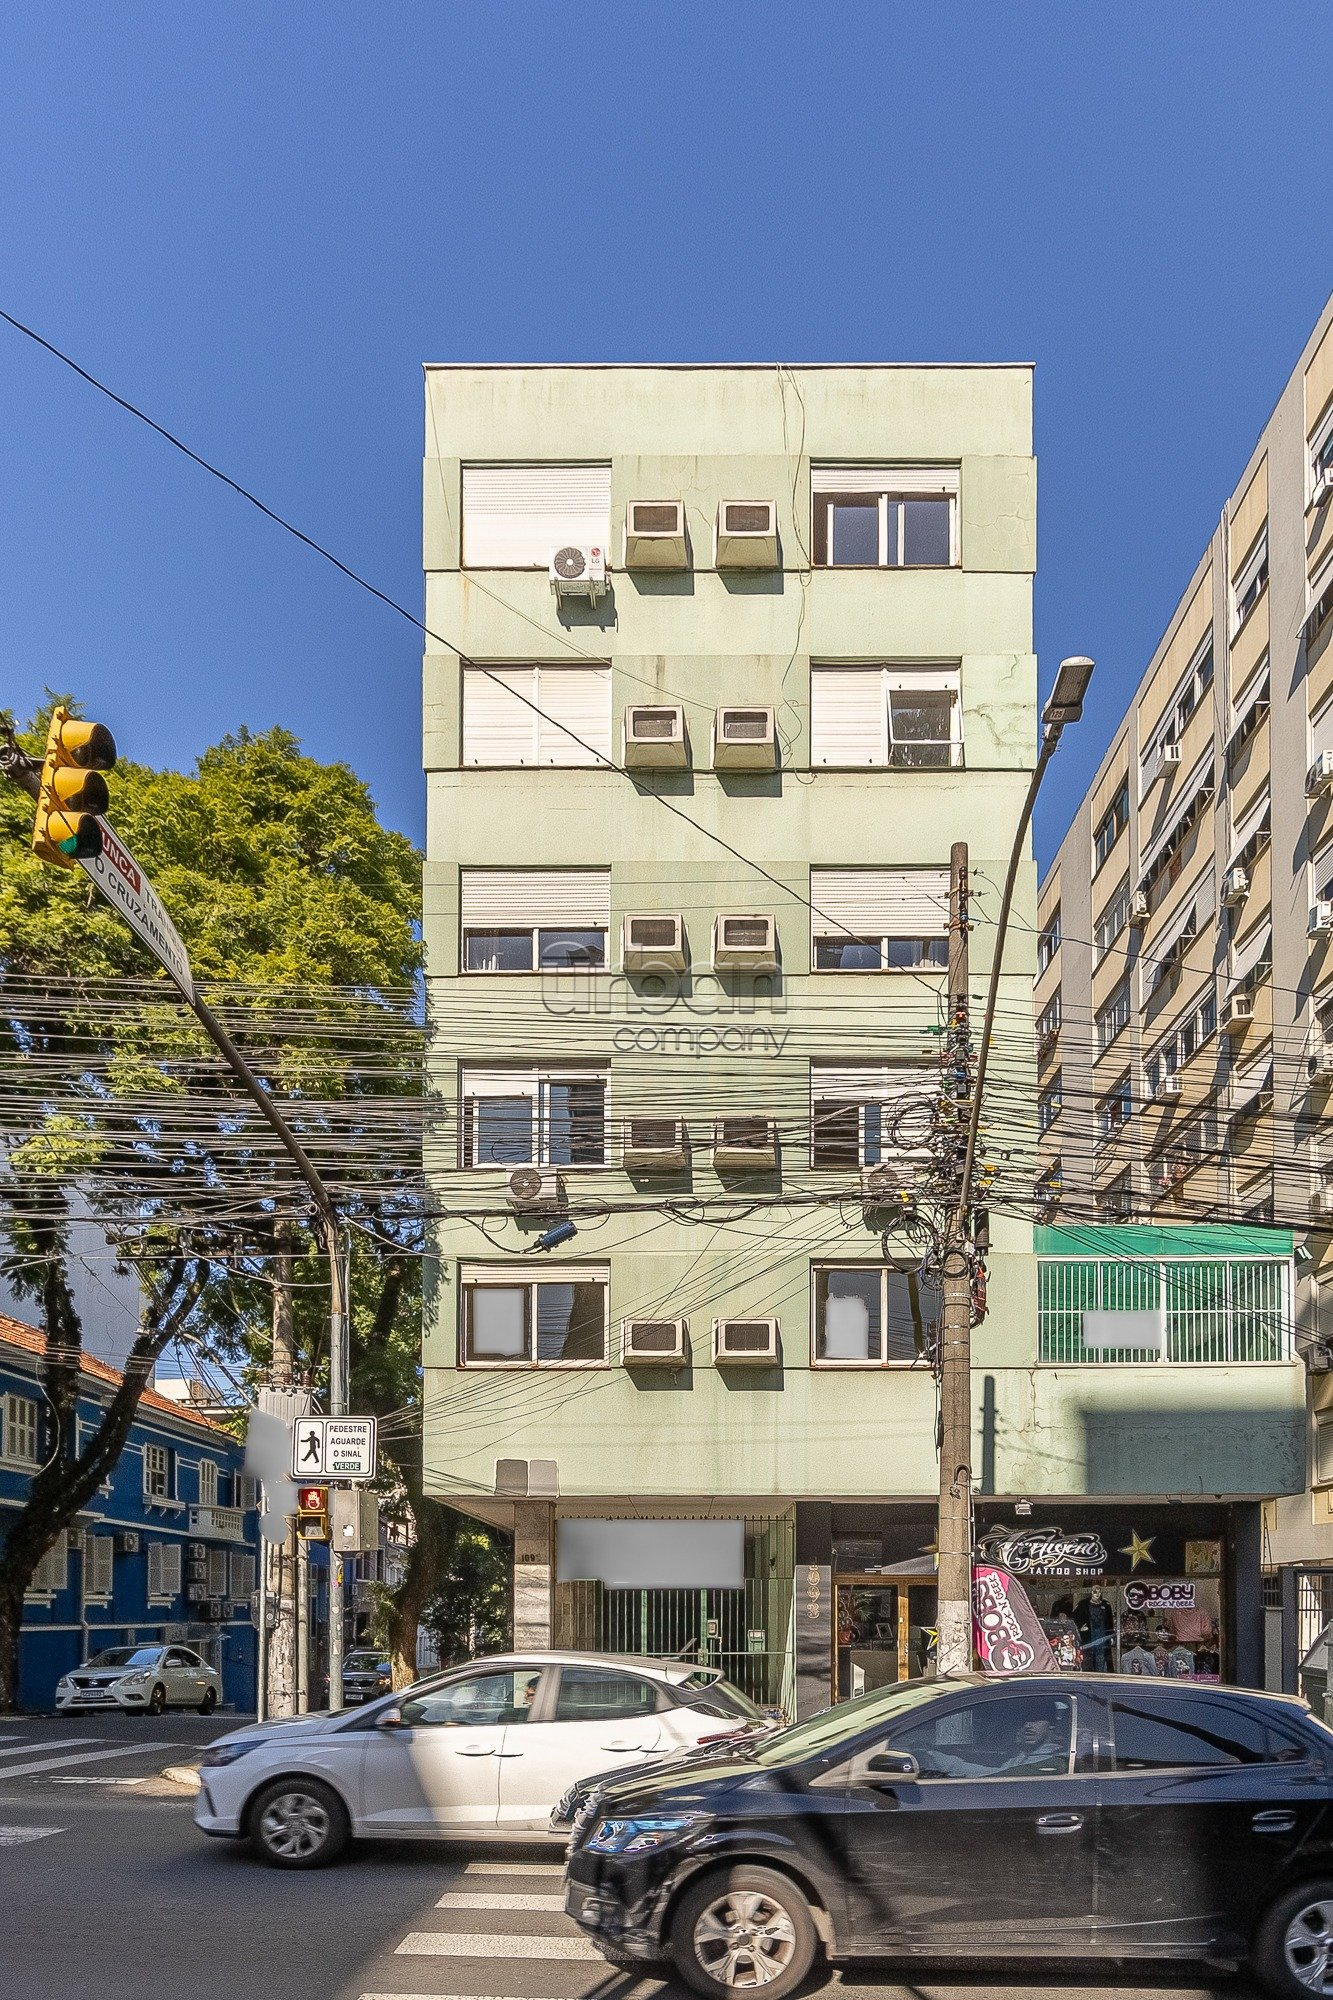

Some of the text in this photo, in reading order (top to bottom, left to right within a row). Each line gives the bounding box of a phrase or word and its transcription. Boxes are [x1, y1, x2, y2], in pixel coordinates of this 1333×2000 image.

[100, 830, 136, 887] UNCA
[107, 872, 183, 976] CRUZAMENTO
[329, 1425, 367, 1433] PEDESTRE
[334, 1462, 360, 1470] VERDE
[1030, 1567, 1103, 1575] TATTOO SHOP
[988, 1573, 1004, 1600] GEEK
[1148, 1585, 1194, 1600] BOBY
[1003, 1610, 1020, 1637] ROCK
